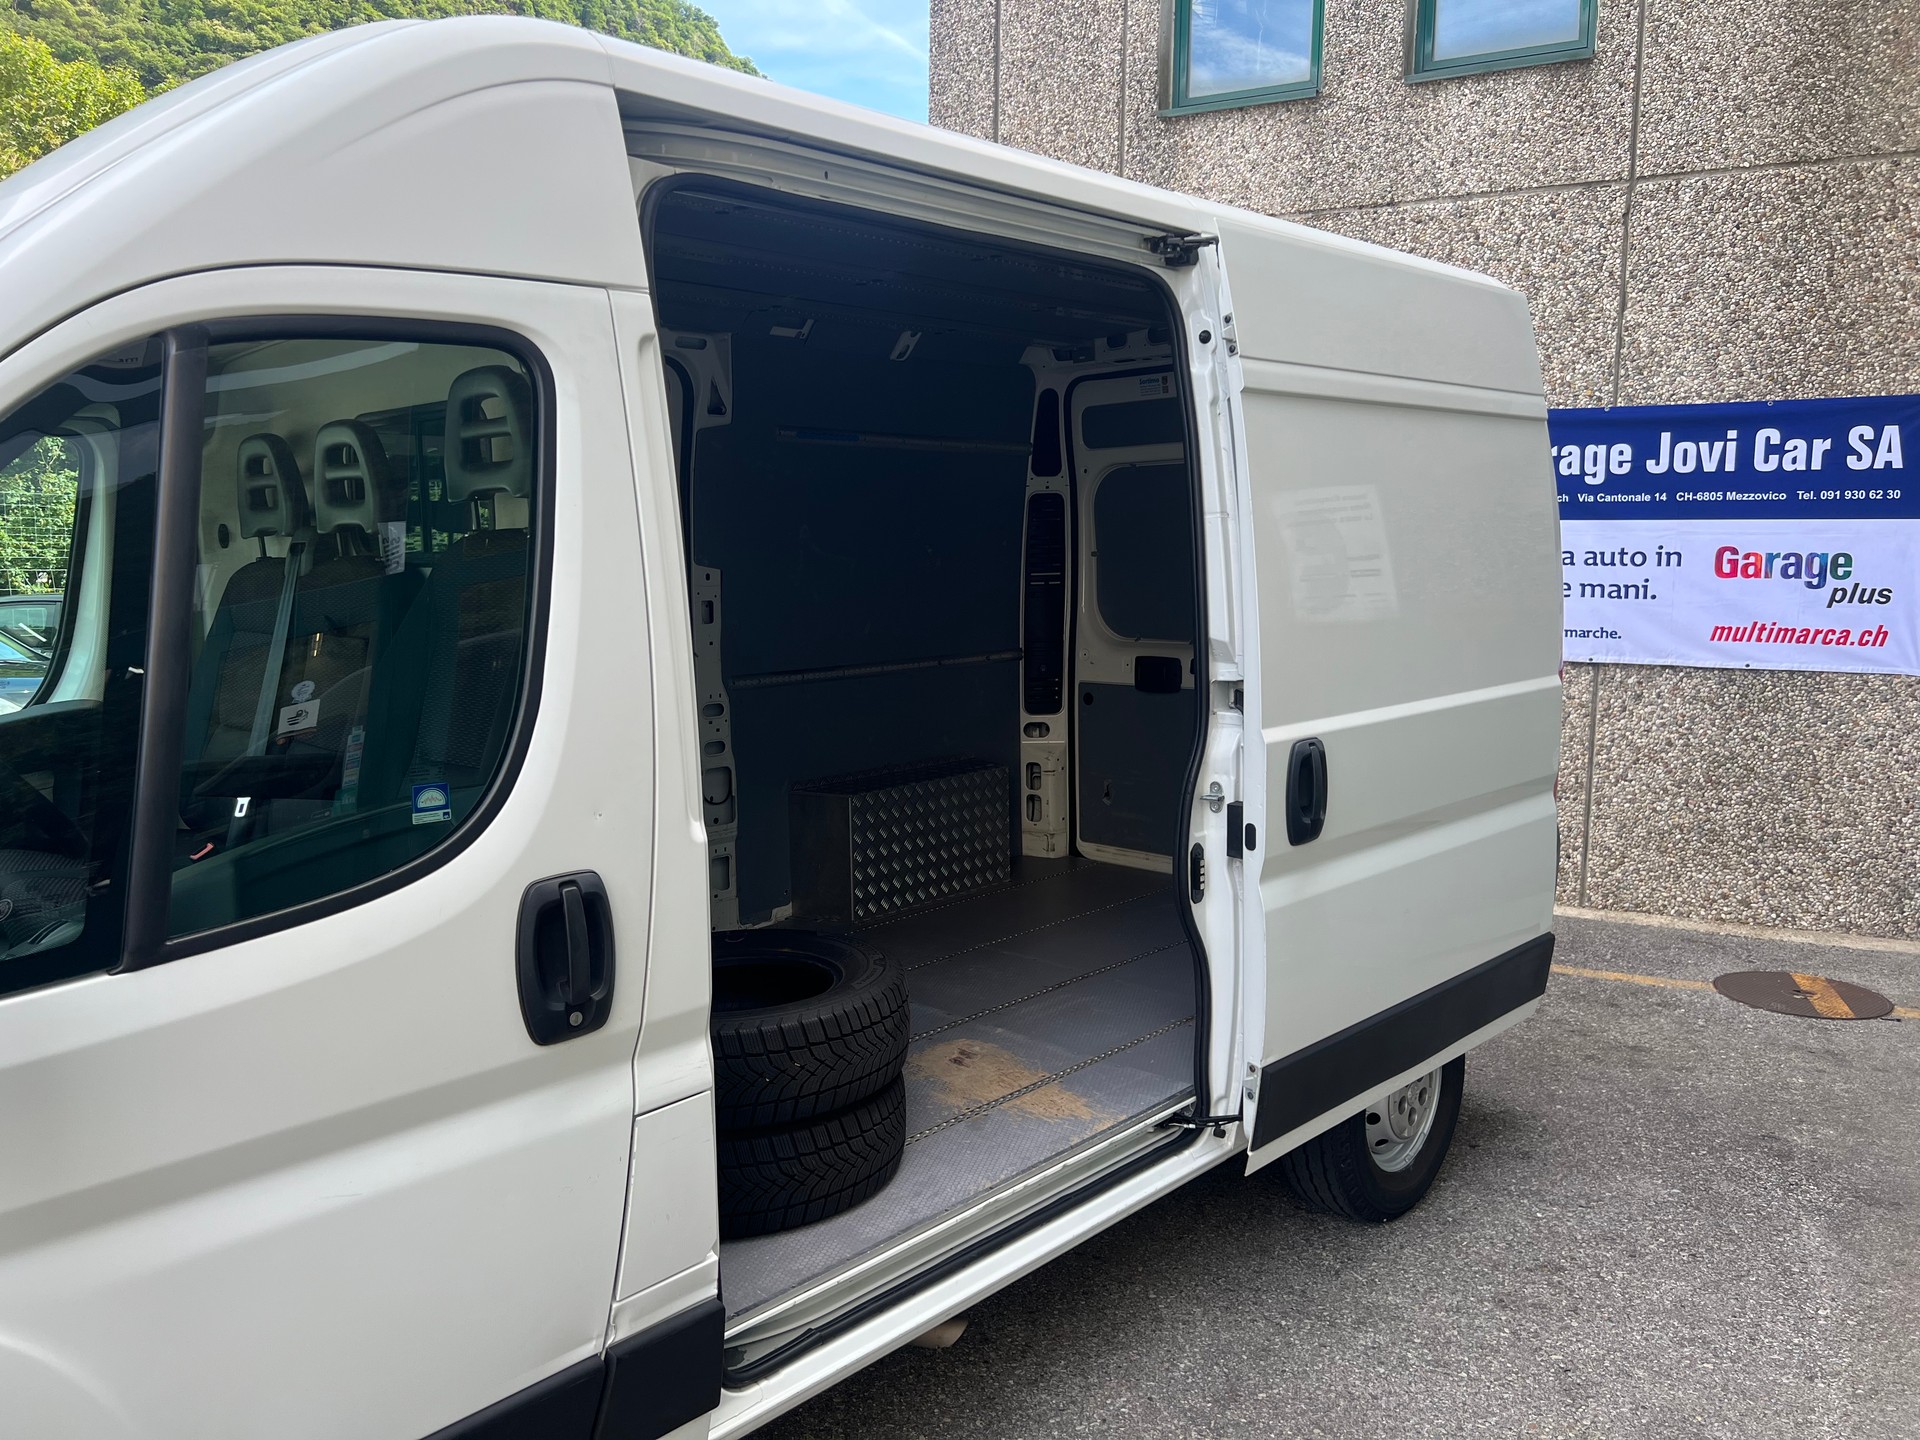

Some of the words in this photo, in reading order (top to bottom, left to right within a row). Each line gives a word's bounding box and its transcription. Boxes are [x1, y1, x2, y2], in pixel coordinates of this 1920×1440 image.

[1646, 430, 1738, 474] Jovi
[1754, 428, 1832, 472] Car
[1846, 425, 1904, 470] SA
[1577, 493, 1594, 502] Via
[1597, 492, 1651, 502] Cantonale
[1655, 492, 1667, 502] 14
[1676, 491, 1723, 501] CH-6805
[1727, 491, 1787, 501] Mezzovico
[1797, 490, 1817, 500] Tel.
[1820, 490, 1841, 500] 091
[1845, 489, 1866, 500] 930
[1869, 489, 1883, 499] 62
[1887, 489, 1901, 499] 30
[1583, 547, 1648, 567] auto
[1655, 545, 1683, 567] in
[1714, 545, 1853, 589] Garage
[1579, 578, 1657, 600] mani.
[1827, 583, 1893, 608] plus
[1564, 627, 1622, 639] marche.
[1709, 621, 1890, 647] multimarca.ch
